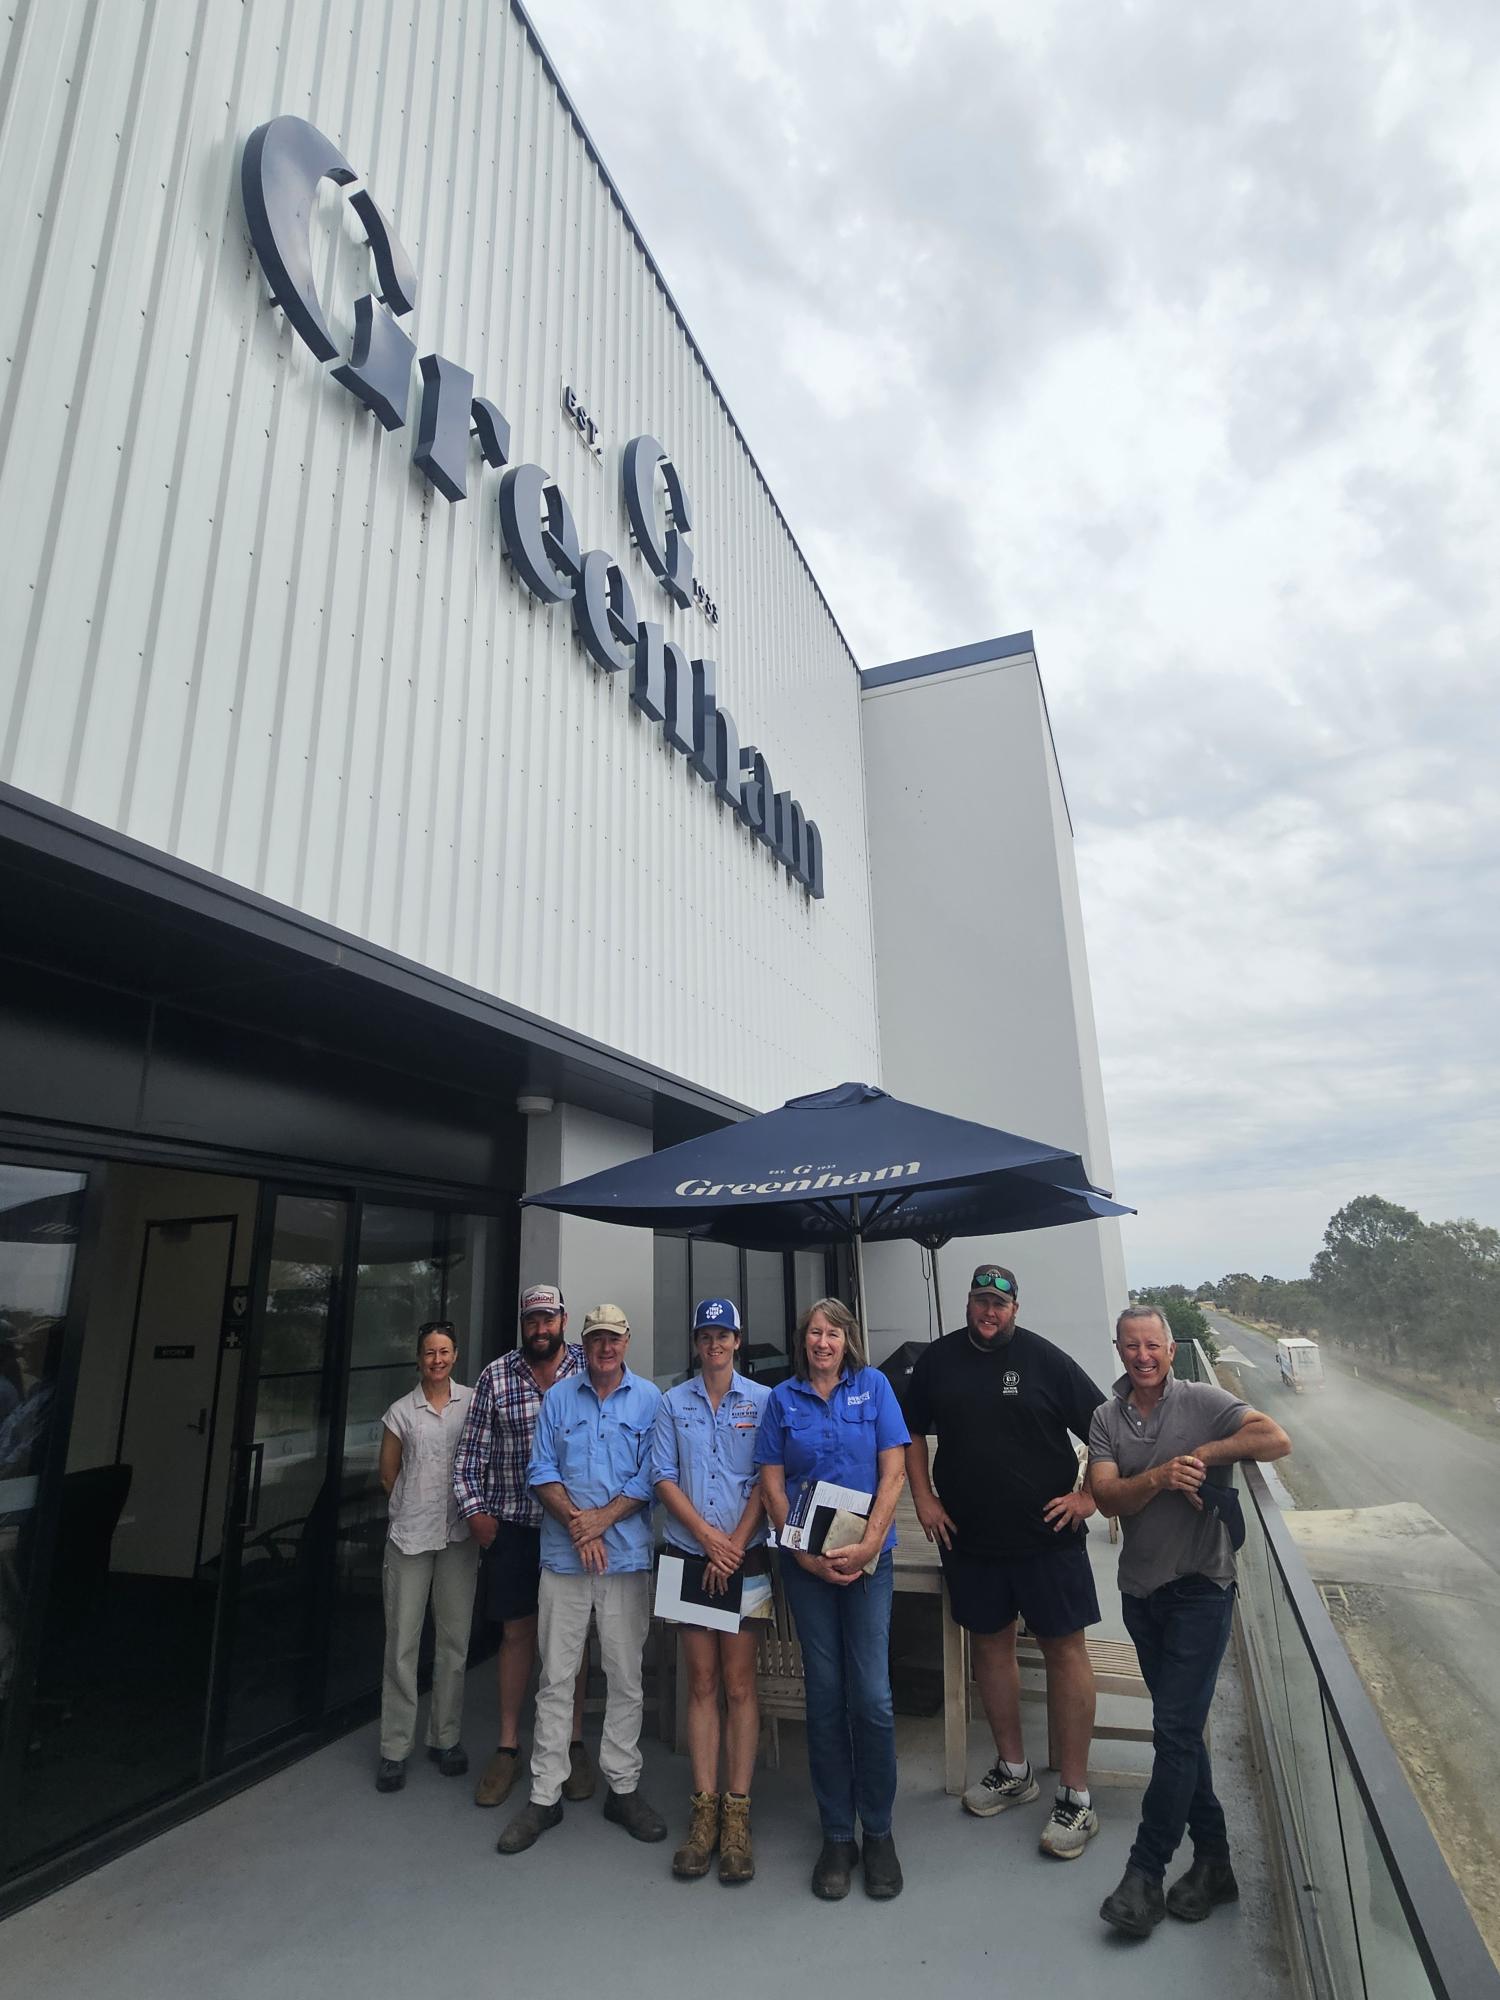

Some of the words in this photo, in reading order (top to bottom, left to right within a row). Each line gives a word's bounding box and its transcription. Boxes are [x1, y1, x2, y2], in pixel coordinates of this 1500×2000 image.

[241, 115, 824, 899] Greenham
[565, 386, 602, 456] EST.
[623, 435, 694, 610] G
[674, 1161, 921, 1197] Greenham
[792, 1164, 812, 1175] G
